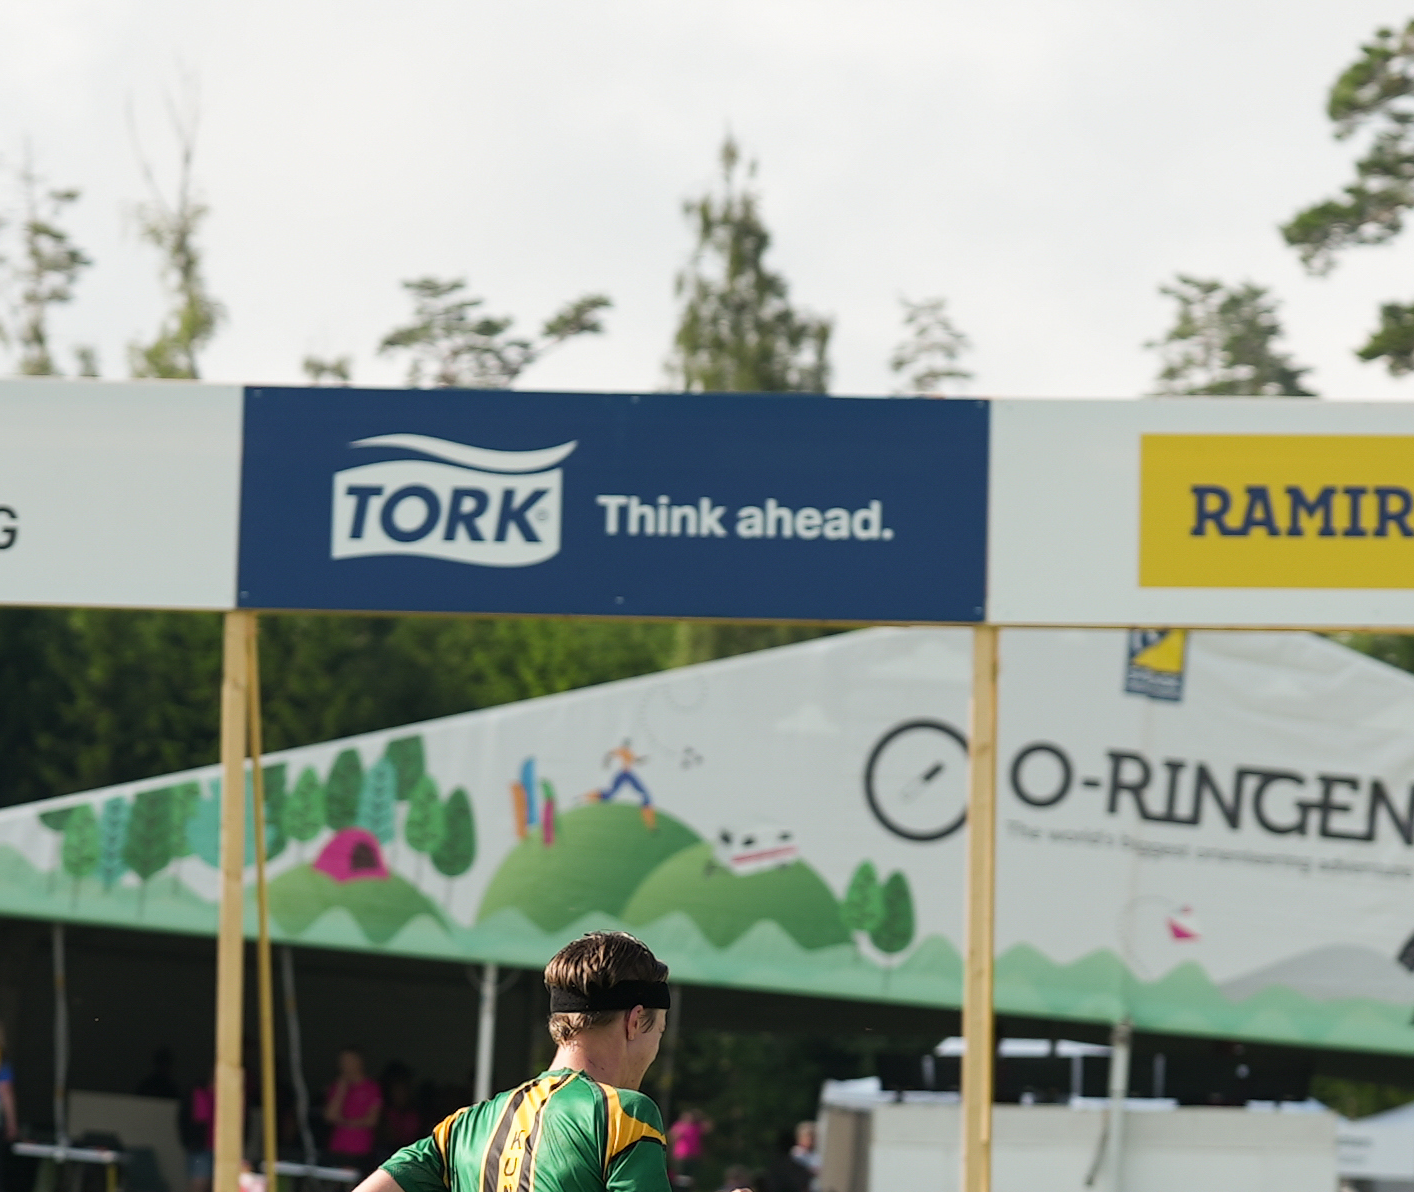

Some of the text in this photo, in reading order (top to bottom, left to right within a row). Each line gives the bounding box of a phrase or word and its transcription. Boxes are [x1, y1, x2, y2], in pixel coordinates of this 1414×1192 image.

[345, 483, 549, 544] TORK
[596, 494, 894, 540] Think ahead.
